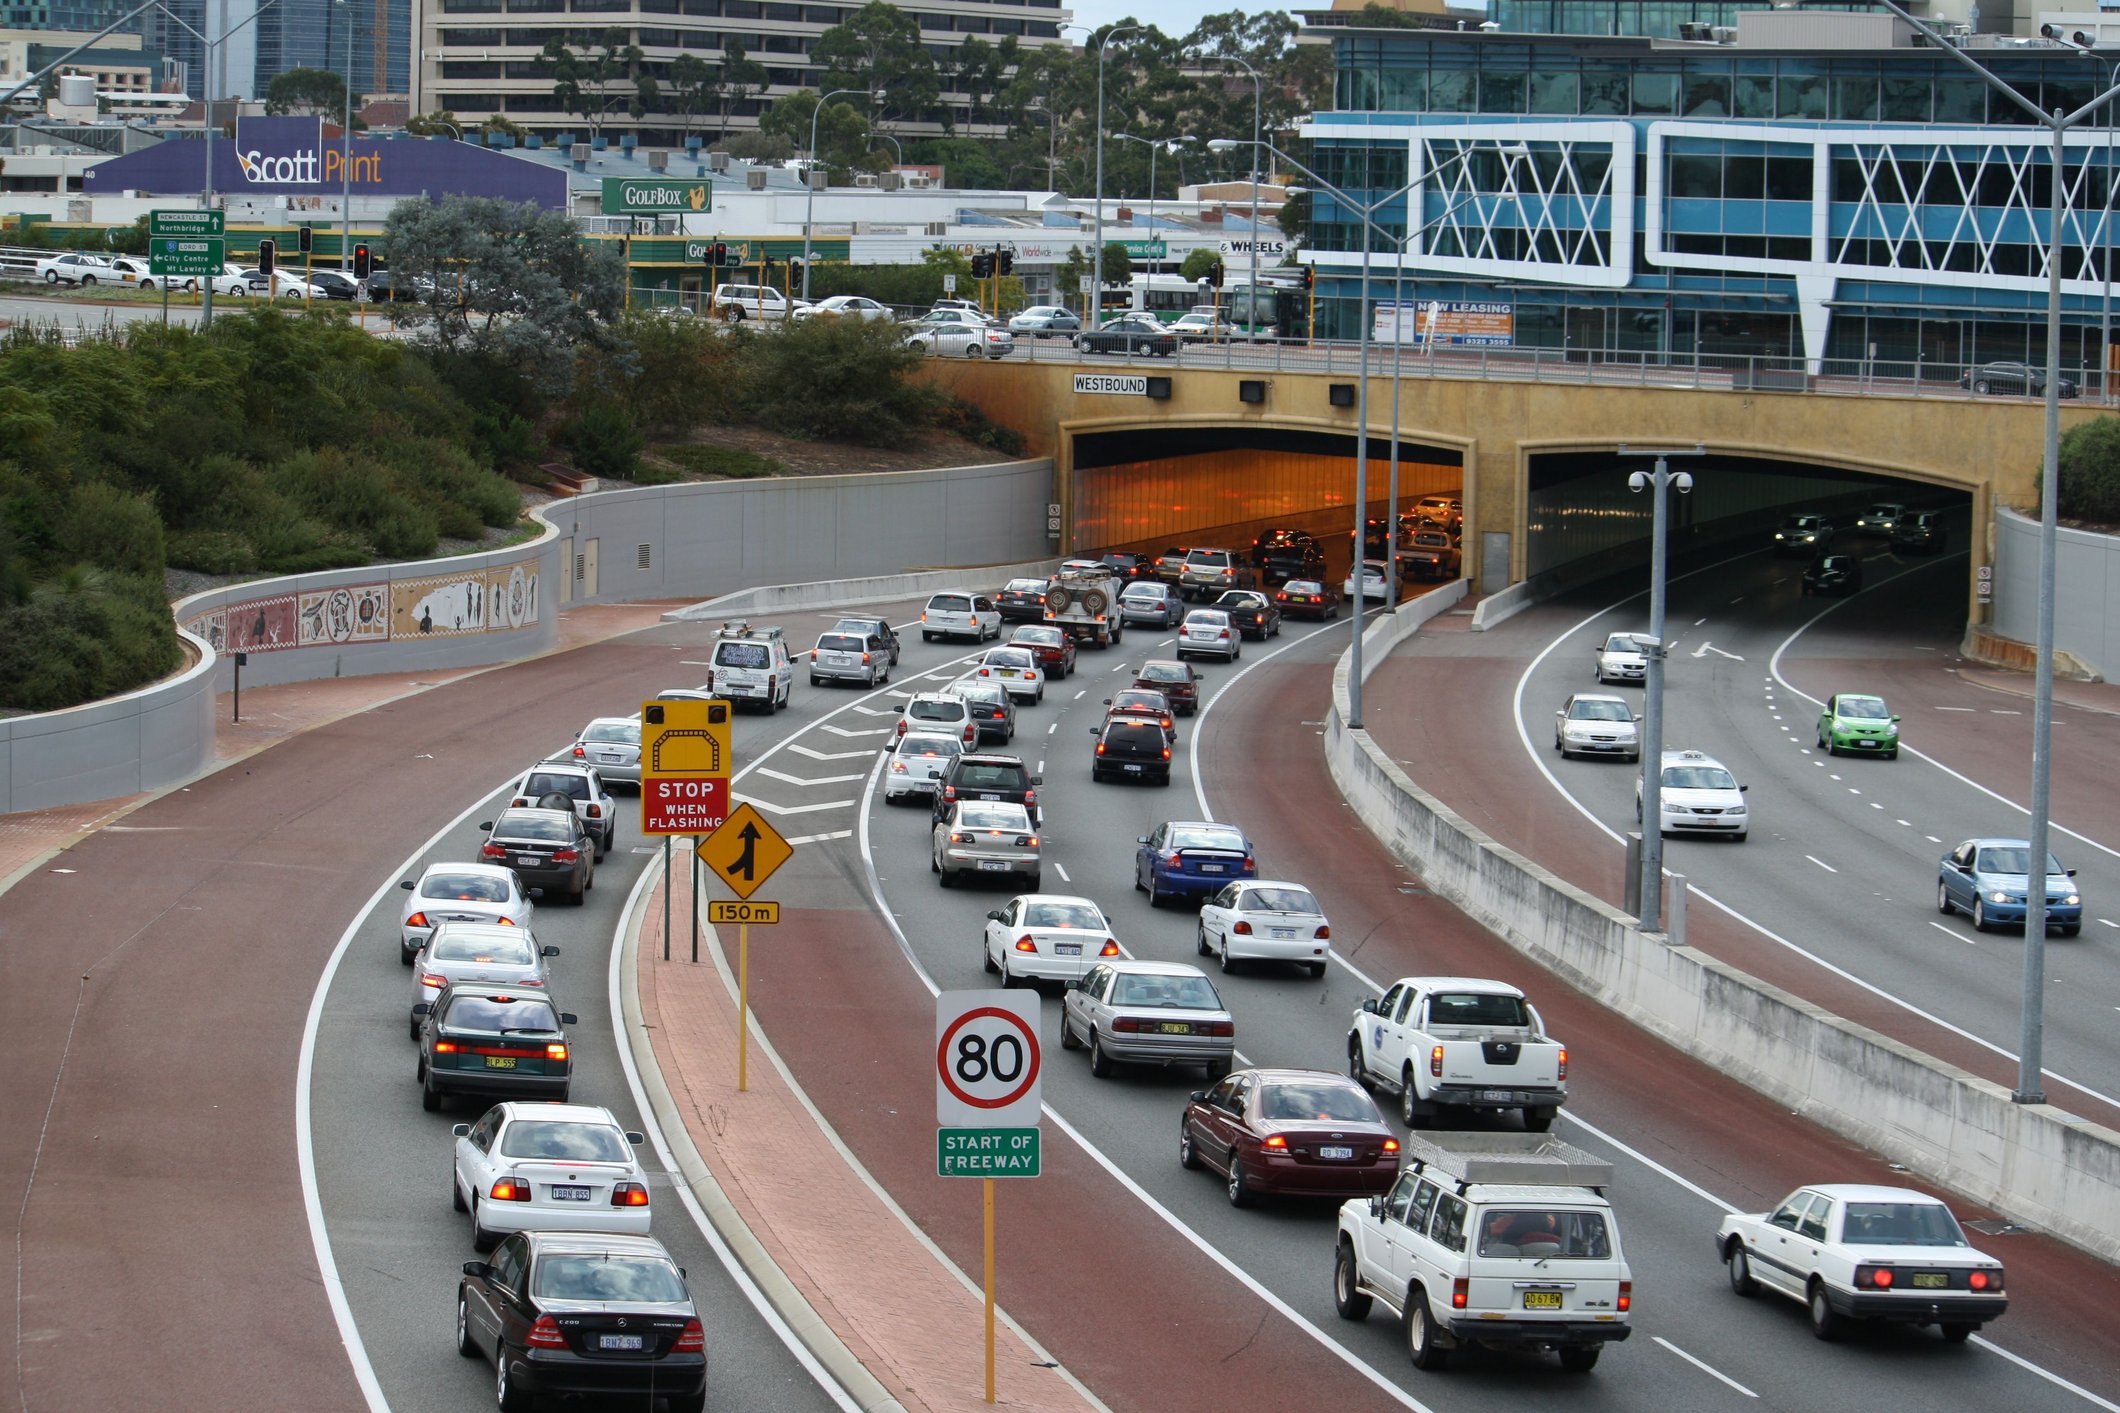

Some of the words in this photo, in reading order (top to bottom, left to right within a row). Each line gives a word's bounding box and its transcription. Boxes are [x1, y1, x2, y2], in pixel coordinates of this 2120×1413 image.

[246, 149, 317, 182] Scott
[326, 150, 382, 182] Print
[85, 170, 96, 178] 40
[160, 225, 205, 233] Northbridge
[1022, 245, 1052, 257] Worldwide
[1231, 241, 1284, 252] WHEELS
[164, 255, 180, 263] City
[180, 265, 207, 274] Lawley
[1452, 304, 1511, 314] LEASING
[1076, 377, 1145, 392] WESTBOUND
[658, 782, 714, 798] STOP
[666, 804, 706, 814] WHEN
[650, 817, 722, 828] FLASHING
[718, 905, 750, 920] 150
[755, 908, 770, 920] m
[956, 1034, 1023, 1082] 80
[946, 1136, 1001, 1149] START
[1011, 1136, 1032, 1149] OF
[945, 1156, 1032, 1168] FREEWAY
